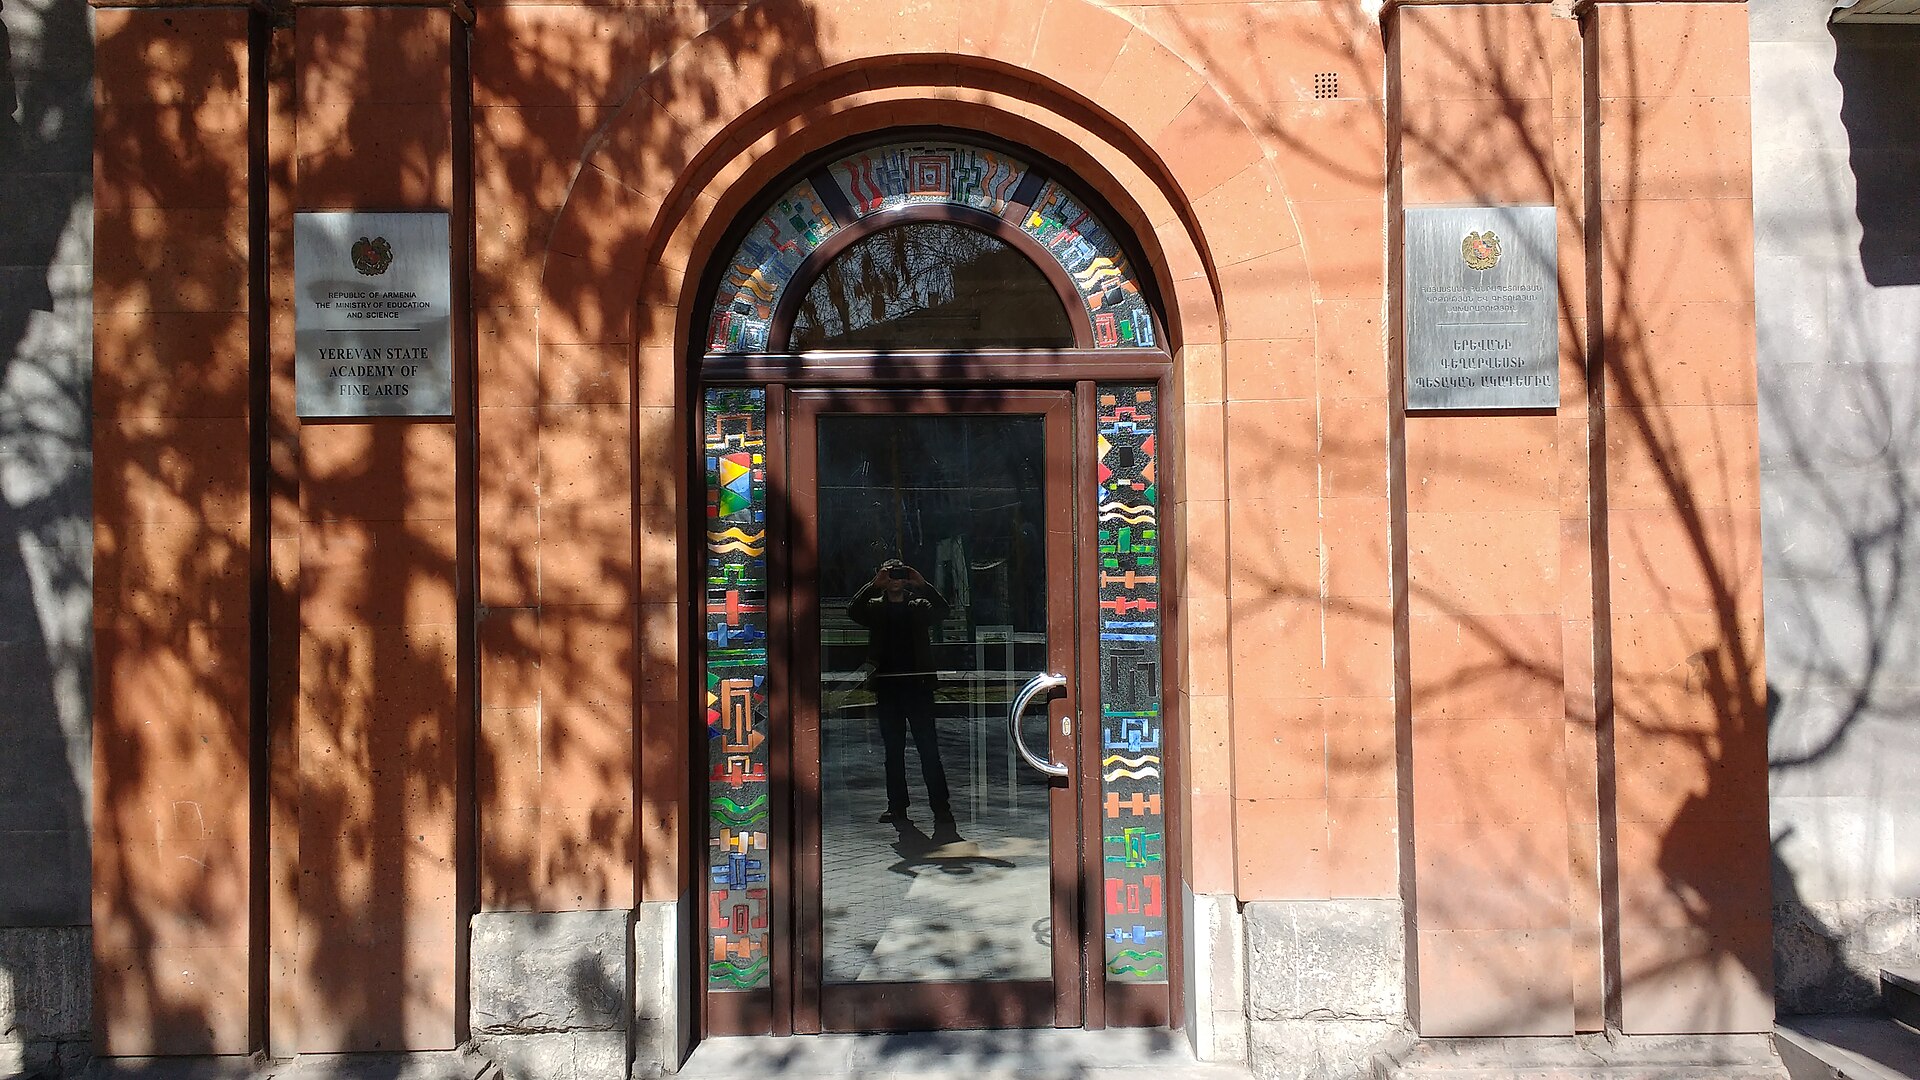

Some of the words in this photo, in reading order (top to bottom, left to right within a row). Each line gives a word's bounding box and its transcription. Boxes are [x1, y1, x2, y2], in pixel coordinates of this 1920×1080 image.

[328, 291, 366, 299] REPUBLIC
[368, 291, 379, 299] OF
[382, 291, 417, 299] ARMENIA
[1453, 339, 1512, 351] ԵՐԵՎԱՆԻ
[318, 348, 381, 360] YEREVAN
[386, 347, 429, 360] STATE
[1440, 357, 1525, 369] ԳԵՂԱՐՎԵՍՏԻ
[329, 365, 396, 378] ACADEMY
[400, 365, 418, 377] OF
[1415, 376, 1475, 388] ՊԵՏԱԿԱՆ
[1480, 375, 1551, 388] ԱԿԱԴԵՄԻԱ
[339, 384, 370, 396] FINE
[374, 384, 409, 396] ARTS
